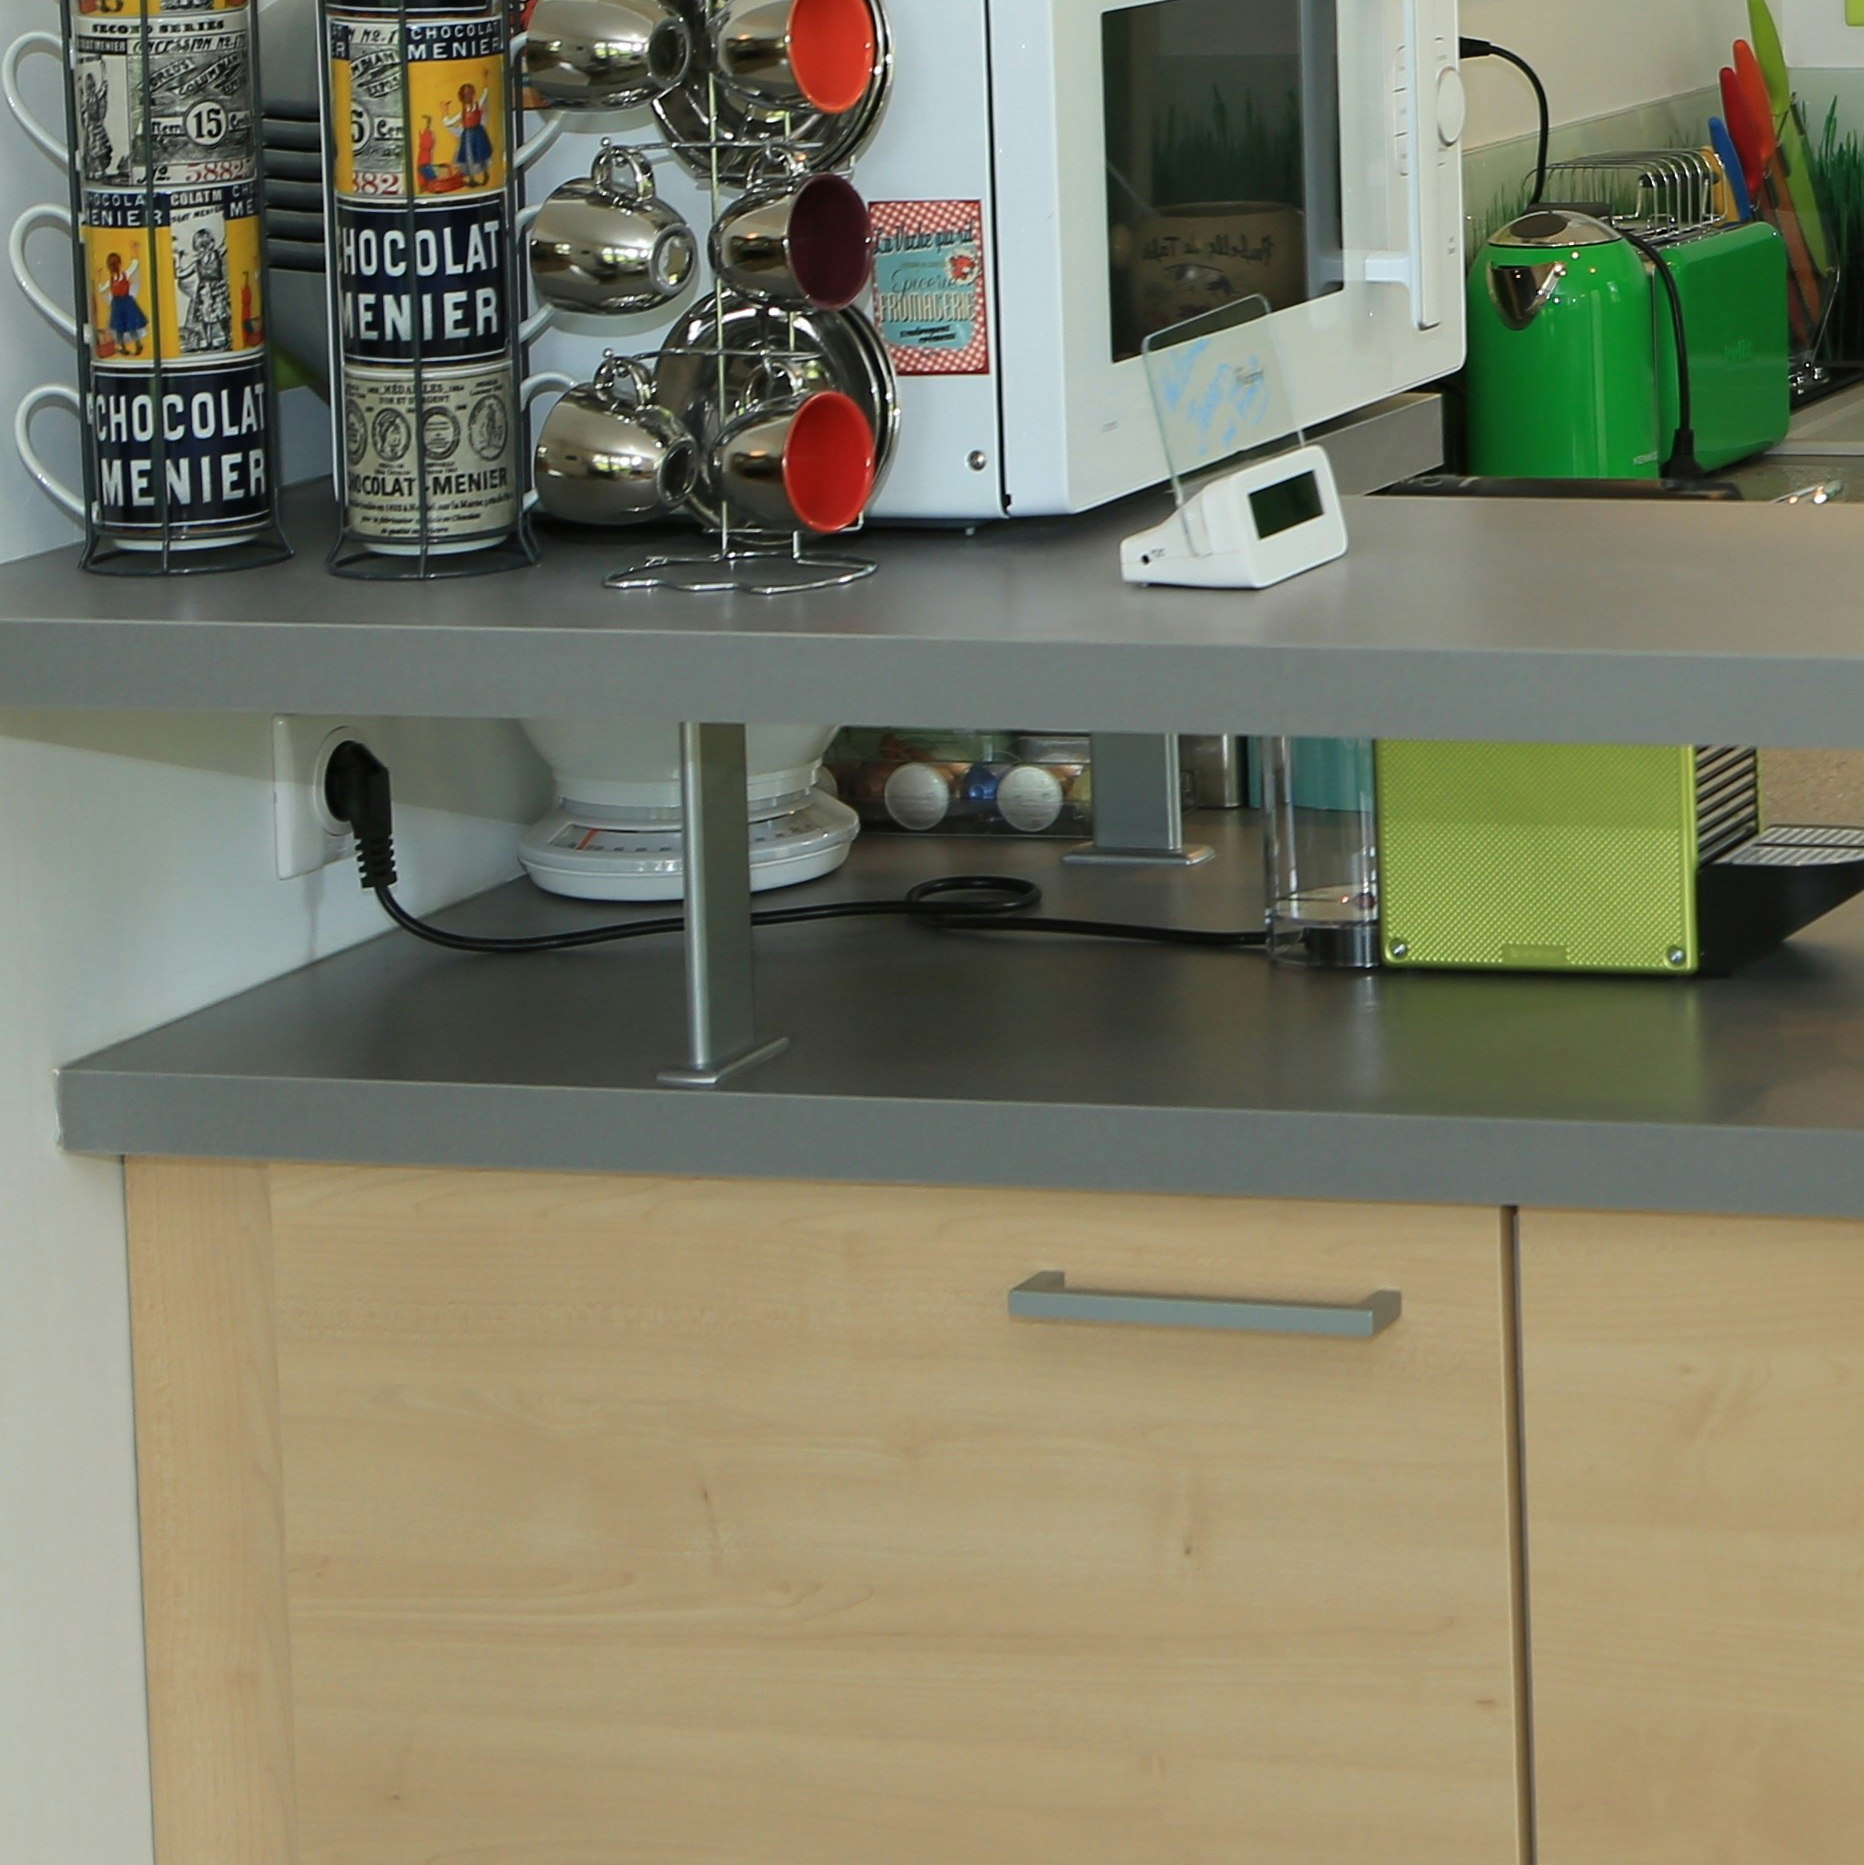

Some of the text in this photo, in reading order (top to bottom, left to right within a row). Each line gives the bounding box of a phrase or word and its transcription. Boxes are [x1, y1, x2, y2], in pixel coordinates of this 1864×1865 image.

[410, 21, 498, 41] CHOCOLAT
[407, 37, 502, 60] MENIER
[193, 107, 223, 141] 15
[343, 220, 499, 277] HOCOLAT
[879, 292, 975, 323] FROMAGERIE
[96, 383, 265, 443] CHOCOLAT
[101, 448, 266, 507] MENIER
